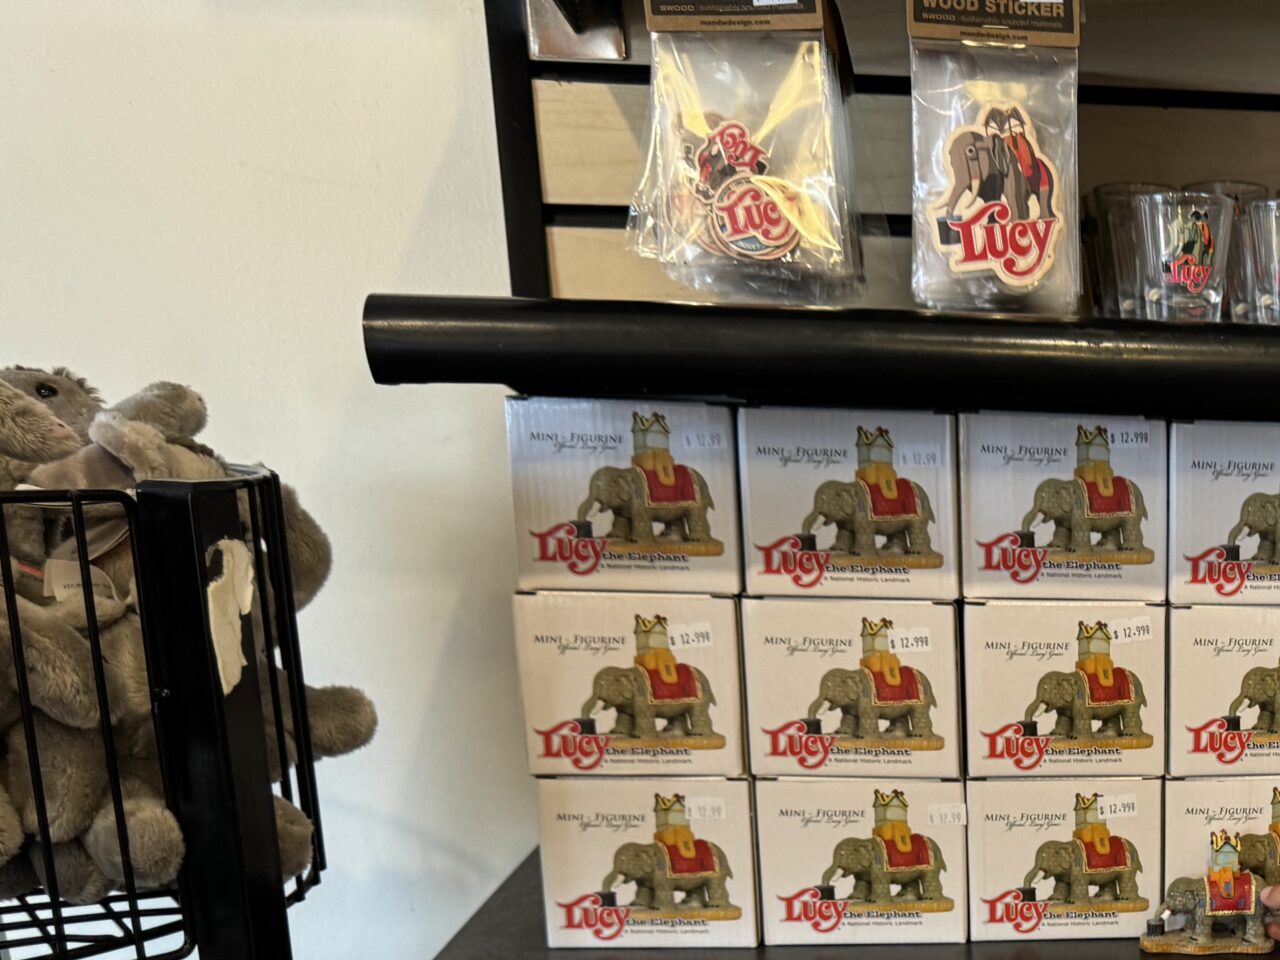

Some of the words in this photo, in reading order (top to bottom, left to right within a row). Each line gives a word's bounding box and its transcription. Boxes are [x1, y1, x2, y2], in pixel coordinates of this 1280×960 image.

[948, 202, 1058, 277] Lucy
[1169, 254, 1212, 294] Lucy
[530, 432, 559, 442] MINI
[570, 433, 623, 444] FIGURINE
[756, 447, 784, 456] MINI
[796, 448, 848, 457] FIGURINE
[981, 445, 1007, 454] MINI
[1019, 445, 1068, 456] FIGURINE
[1191, 460, 1216, 470] MINI
[1227, 461, 1274, 471] FIGURINE
[529, 522, 609, 576] Lucy
[628, 553, 689, 562] Elephant
[754, 535, 831, 588] Lucy
[826, 565, 847, 573] the
[850, 565, 910, 575] Elephant
[975, 532, 1049, 584] Lucy
[1043, 561, 1063, 569] the
[1066, 561, 1121, 571] Elephant
[1183, 547, 1253, 597] Lucy
[534, 635, 563, 644] MINI
[574, 635, 626, 645] FIGURINE
[764, 637, 791, 645] MINI
[803, 637, 853, 647] FIGURINE
[985, 642, 1010, 650] MINI
[1022, 642, 1070, 650] FIGURINE
[1193, 638, 1218, 646] MINI
[1228, 638, 1274, 647] FIGURINE
[533, 720, 612, 771] Lucy
[631, 747, 690, 758] Elephant
[761, 721, 836, 769] Lucy
[854, 748, 911, 757] Elephant
[981, 723, 1052, 771] Lucy
[1186, 719, 1255, 764] Lucy
[557, 814, 584, 822] MINI
[595, 813, 645, 822] FIGURINE
[779, 809, 806, 817] MINI
[817, 809, 865, 818] FIGURINE
[1020, 813, 1067, 821] FIGURINE
[1185, 807, 1210, 815] MINI
[1220, 807, 1264, 815] FIGURINE
[555, 894, 632, 941] Lucy
[650, 919, 708, 927] Elephant
[777, 887, 849, 933] Lucy
[867, 911, 922, 919] Elephant
[981, 889, 1049, 934] Lucy
[1066, 911, 1118, 920] Elephant
